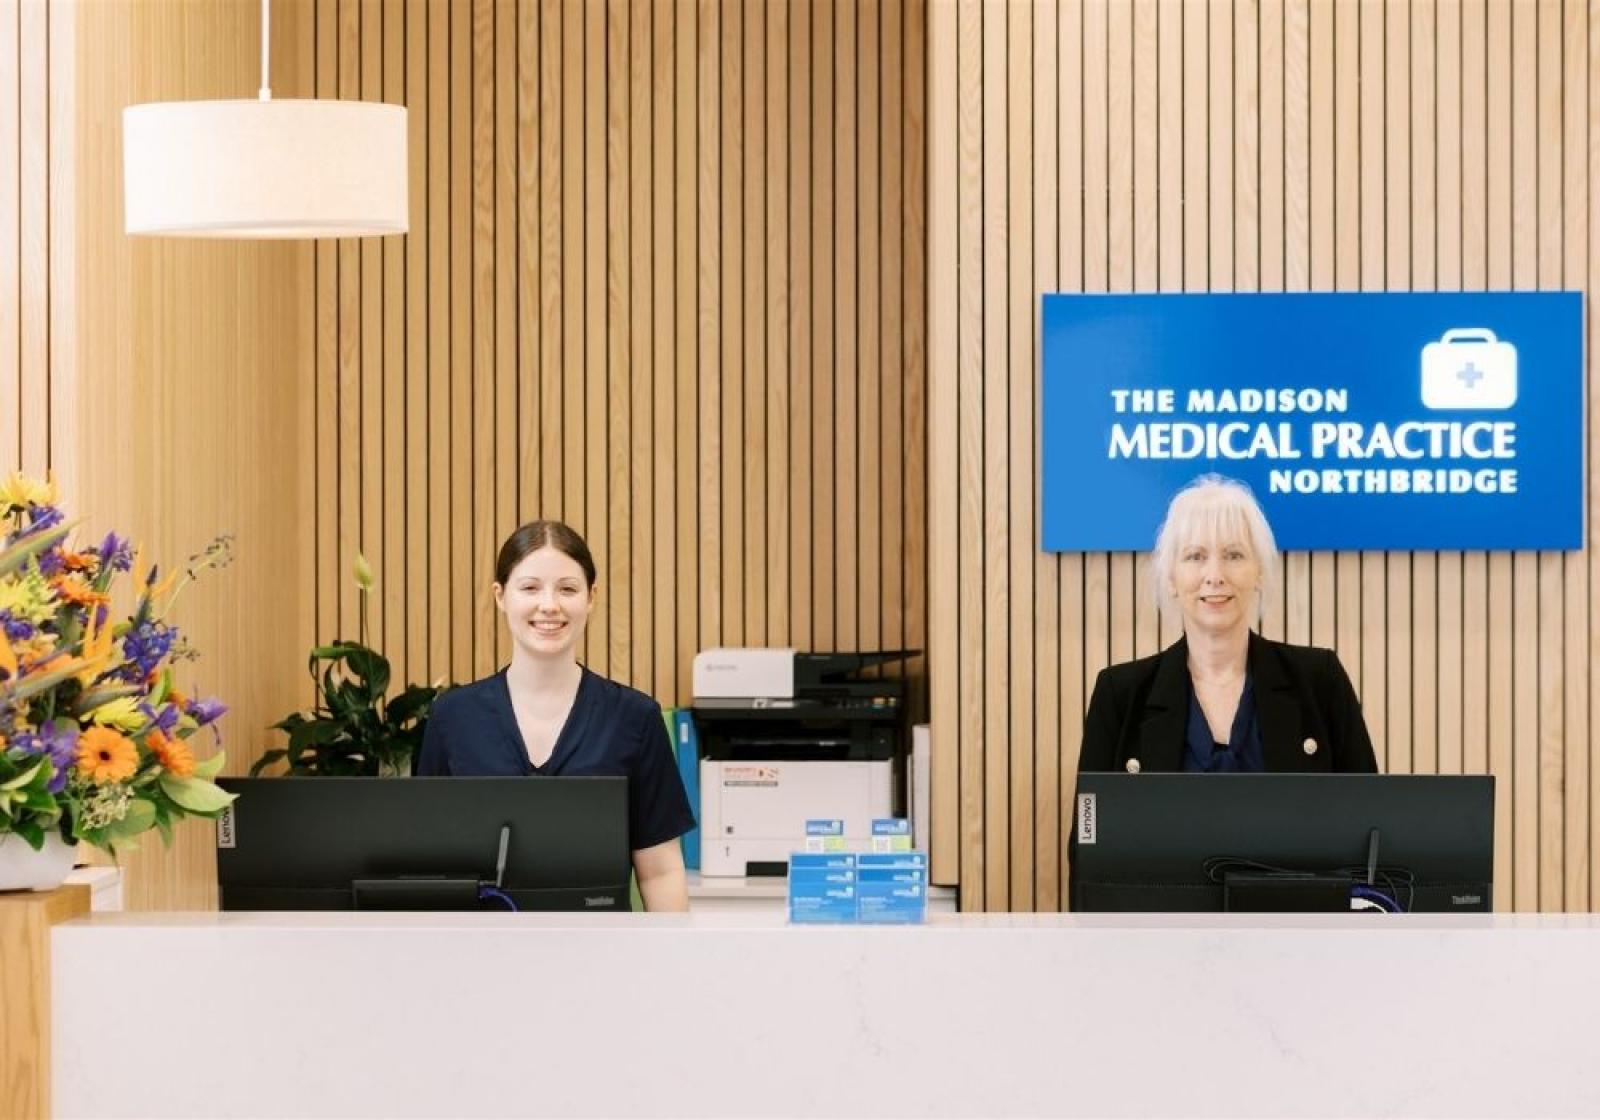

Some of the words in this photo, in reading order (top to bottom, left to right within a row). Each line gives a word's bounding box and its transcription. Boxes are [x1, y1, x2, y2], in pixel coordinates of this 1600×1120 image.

[1111, 389, 1174, 412] THE
[1187, 389, 1347, 412] MADISON
[1108, 421, 1301, 459] MEDICAL
[1311, 421, 1516, 459] PRACTICE
[1270, 469, 1517, 493] NORTHBRIDGE
[221, 807, 232, 844] Lenov
[1082, 797, 1092, 840] Lenovo
